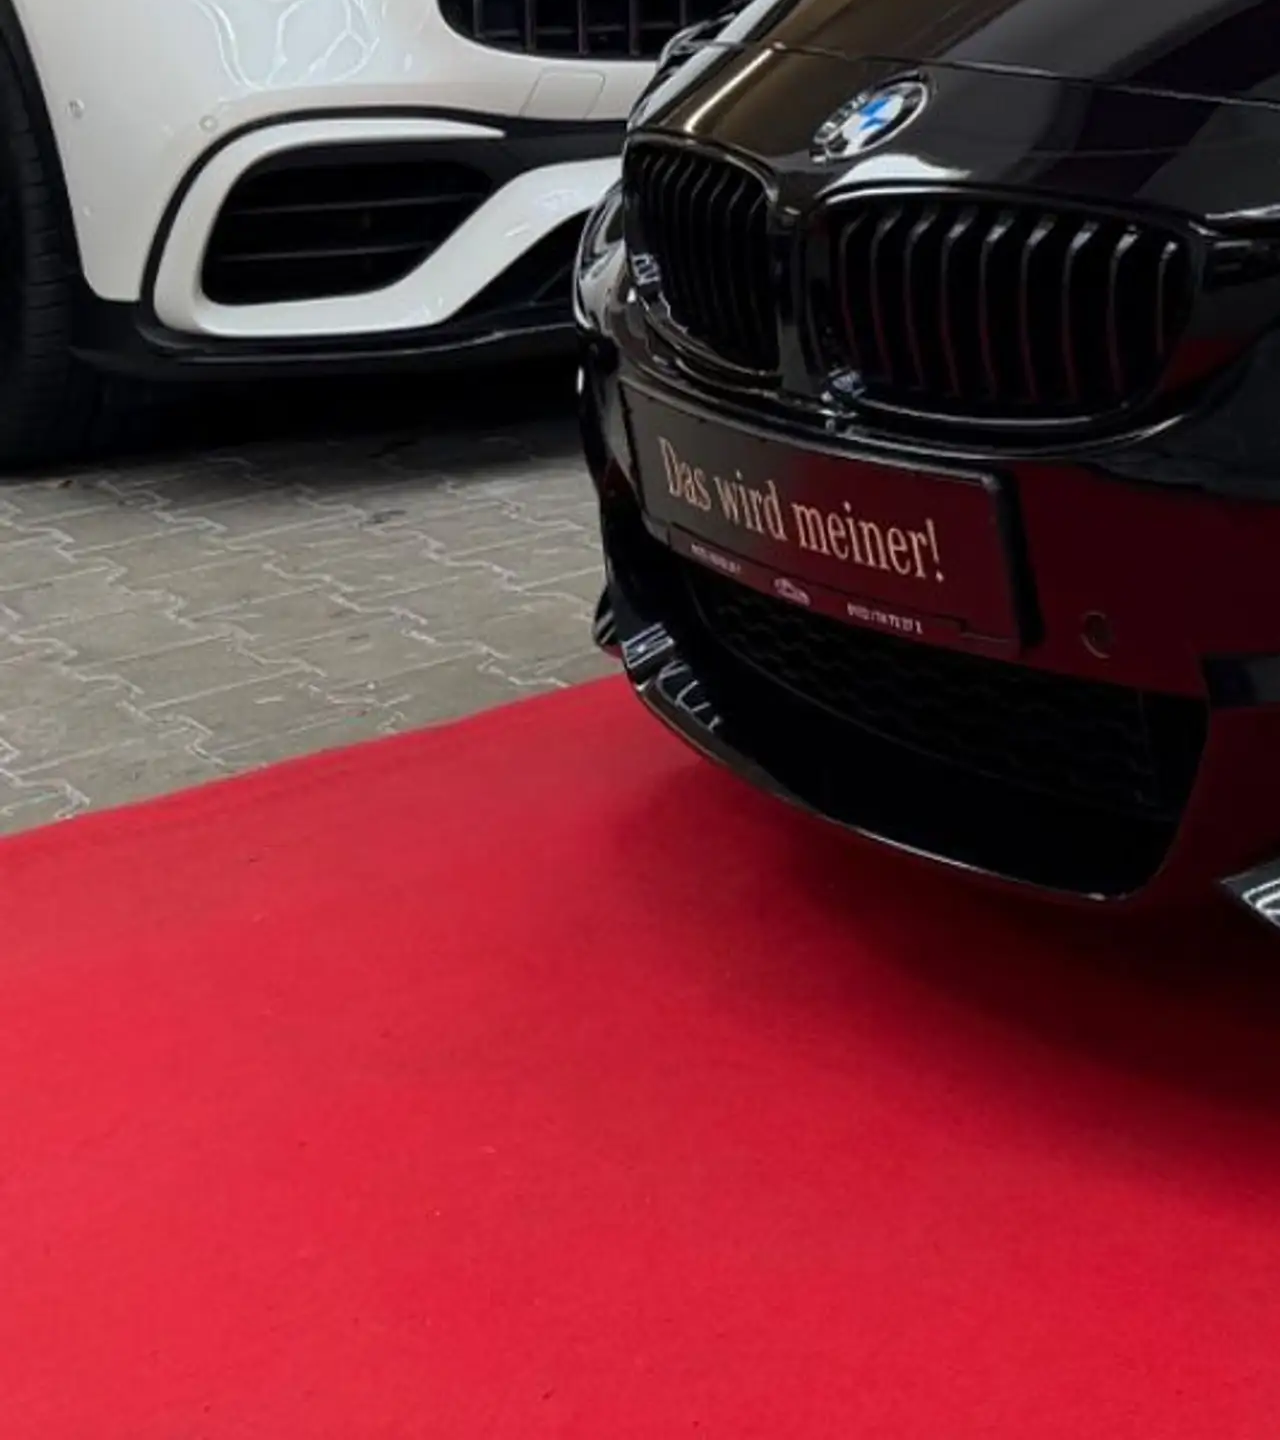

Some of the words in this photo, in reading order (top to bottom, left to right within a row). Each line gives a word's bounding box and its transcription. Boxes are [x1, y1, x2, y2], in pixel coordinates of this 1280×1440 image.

[658, 436, 711, 511] Das
[713, 469, 788, 541] wird
[791, 501, 944, 582] meiner!
